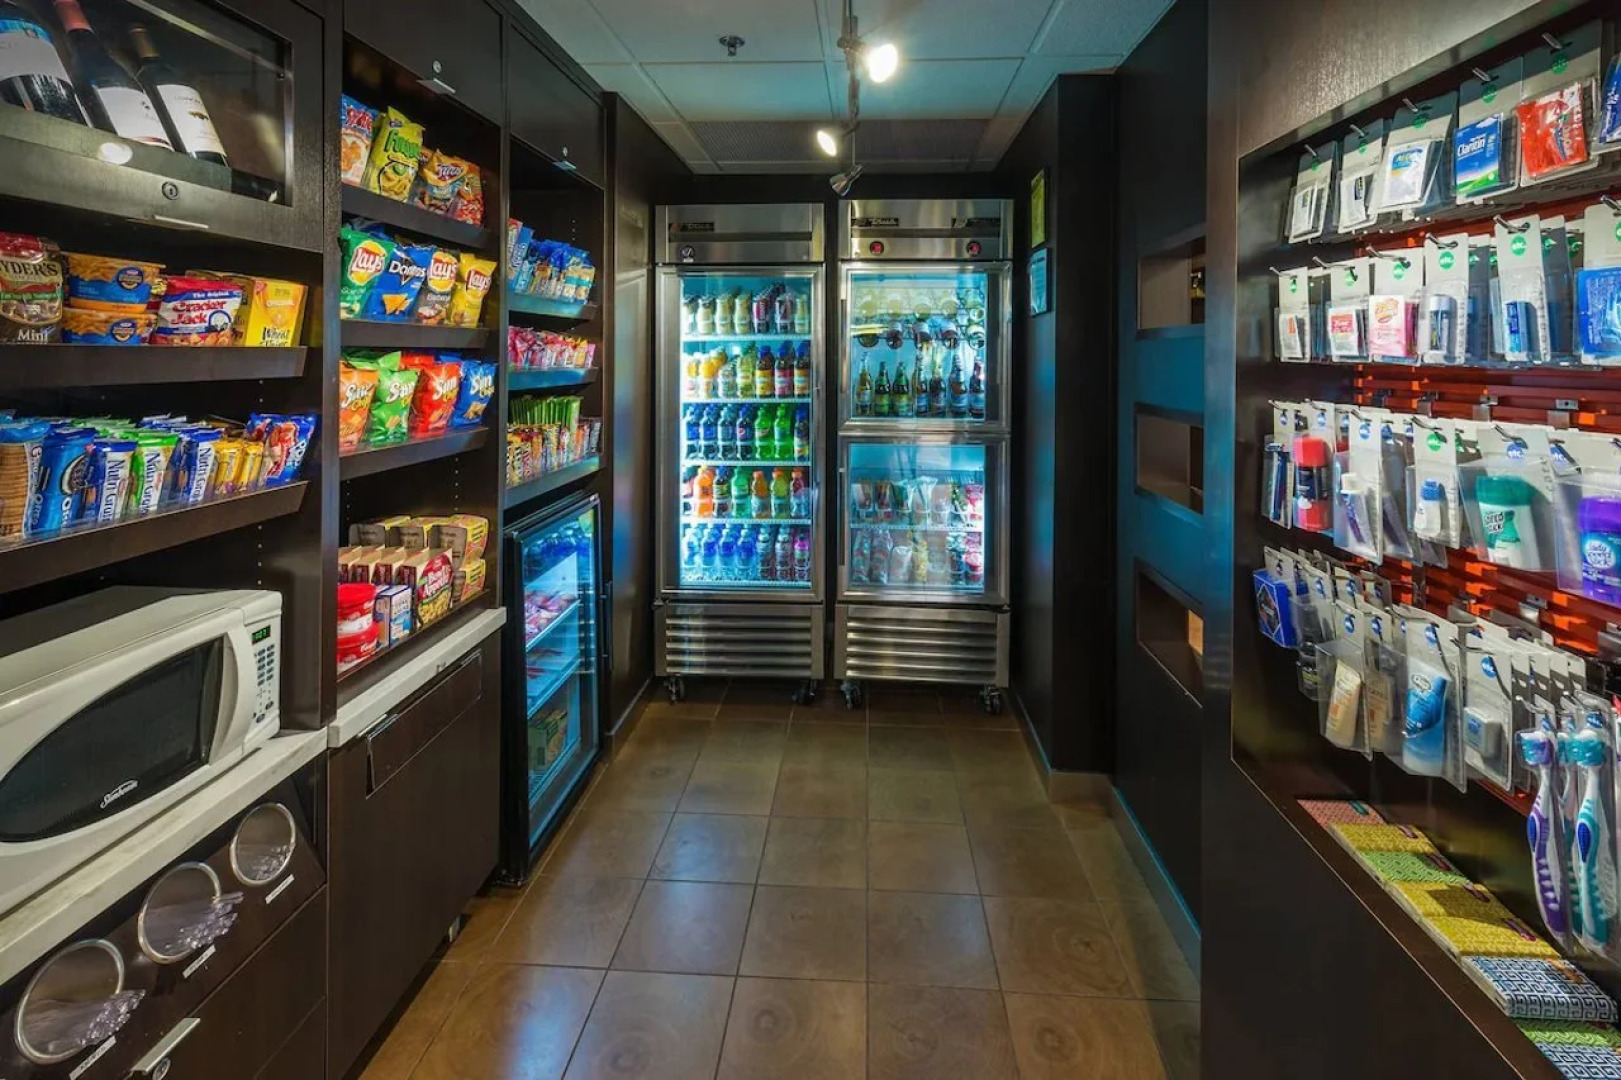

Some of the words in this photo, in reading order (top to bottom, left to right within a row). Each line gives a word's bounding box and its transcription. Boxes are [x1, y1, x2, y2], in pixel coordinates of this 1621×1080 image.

[389, 260, 426, 277] Doritos
[172, 301, 227, 312] Cracker
[170, 313, 207, 325] Jack
[432, 376, 458, 401] Sun
[106, 459, 125, 491] Nutri
[144, 452, 161, 485] Nutri
